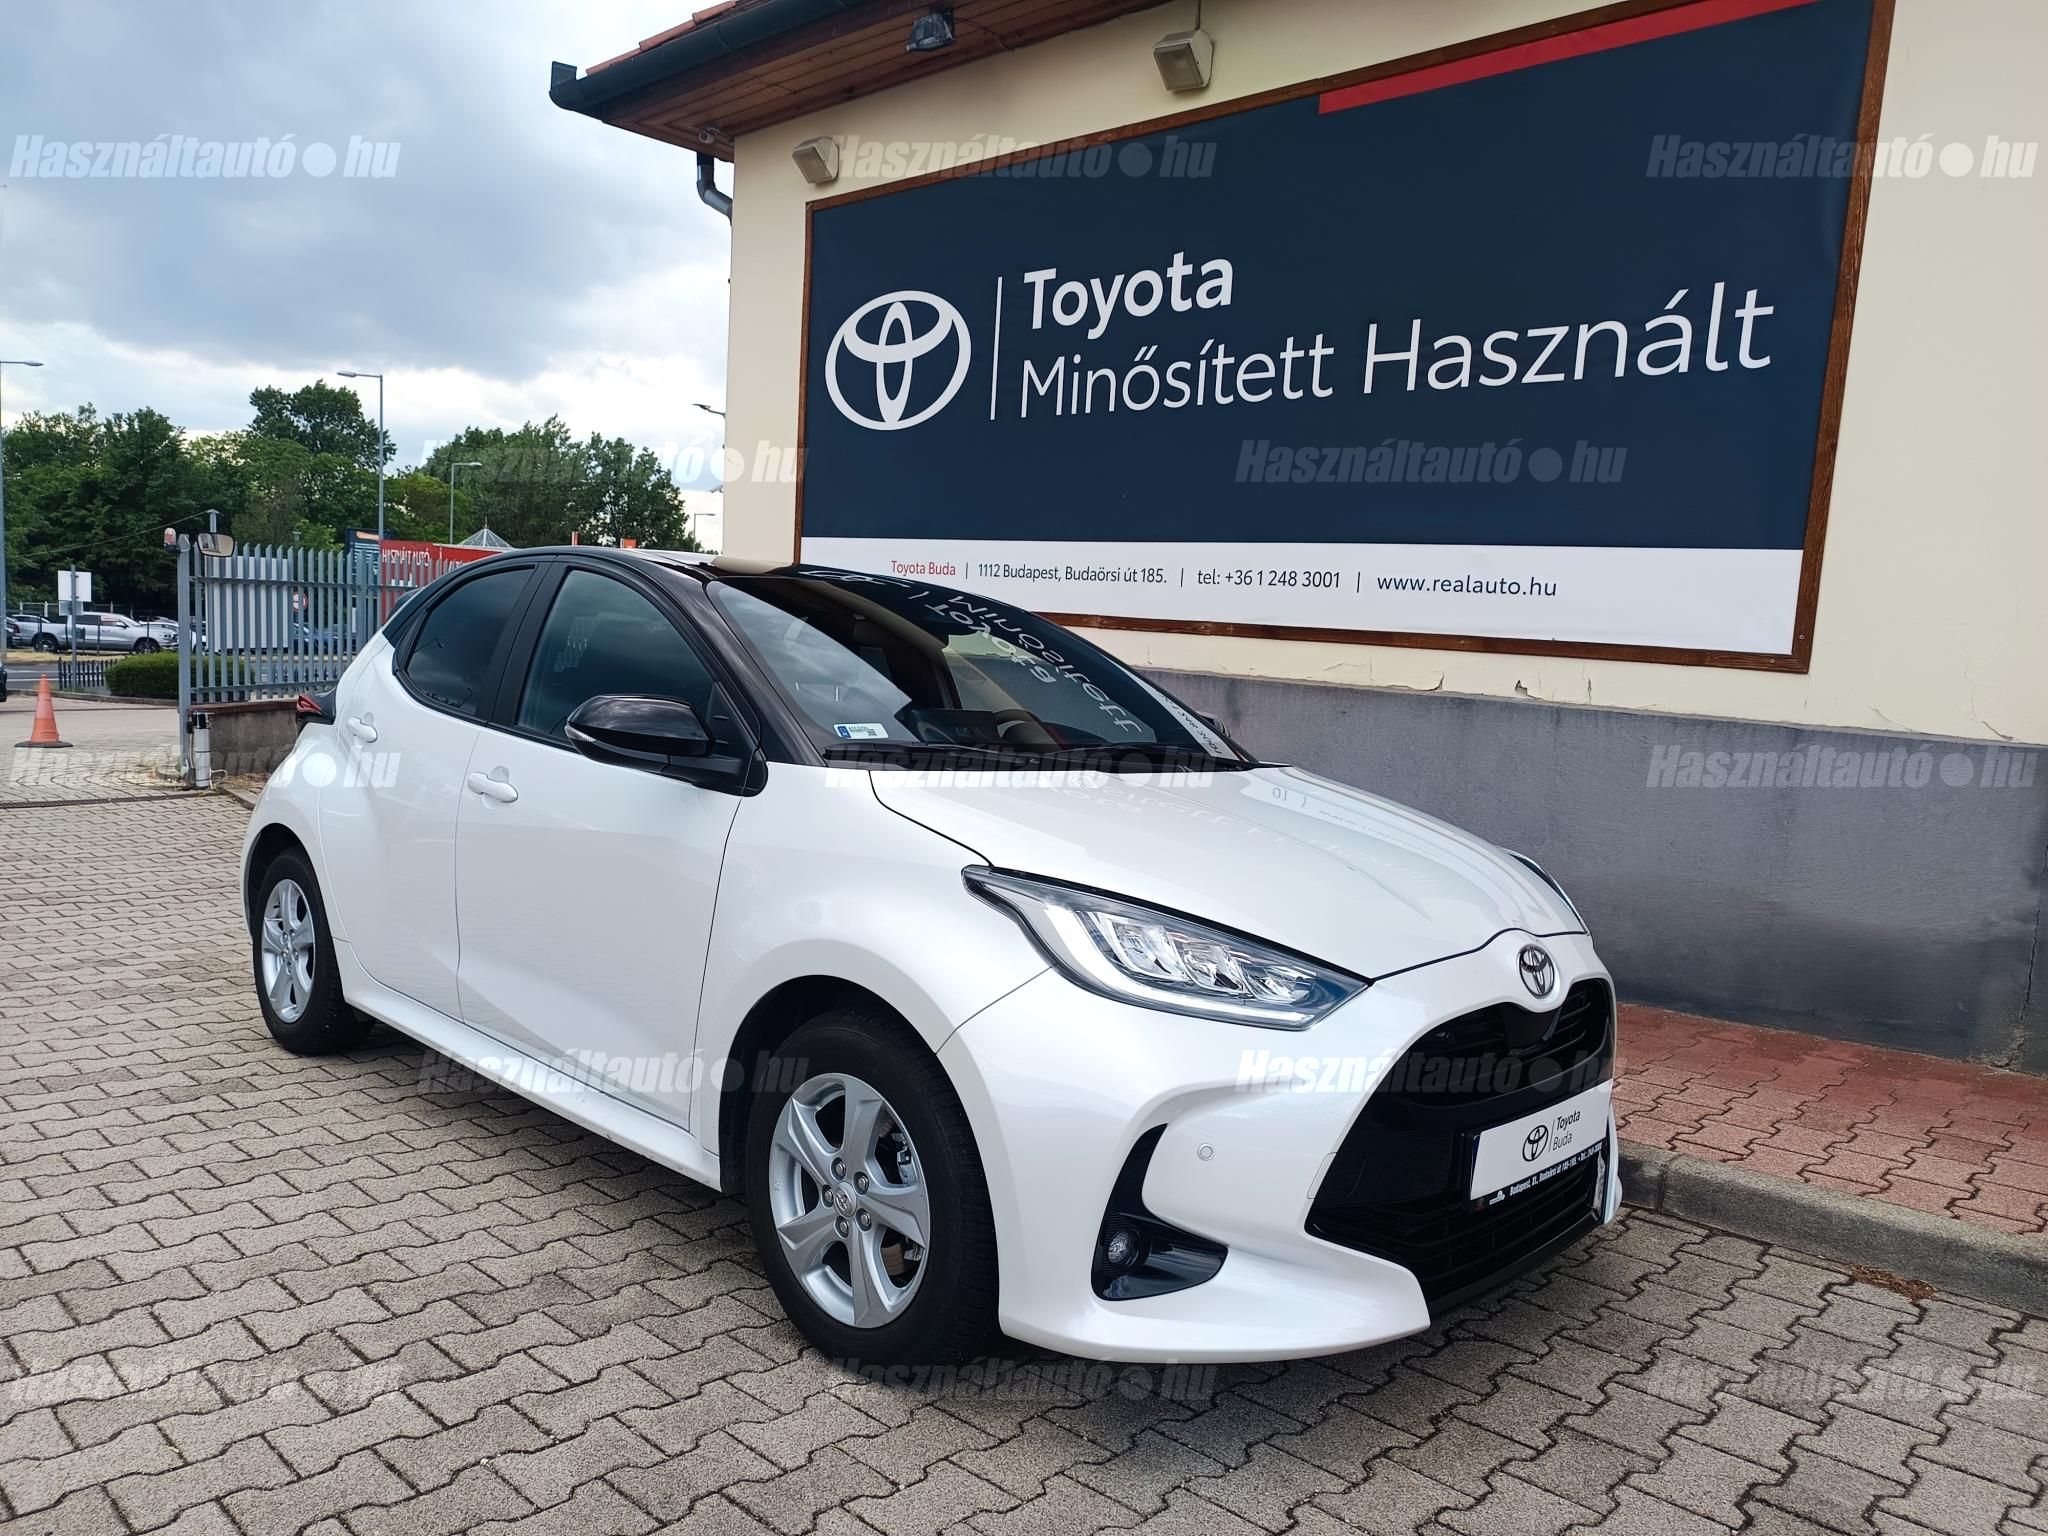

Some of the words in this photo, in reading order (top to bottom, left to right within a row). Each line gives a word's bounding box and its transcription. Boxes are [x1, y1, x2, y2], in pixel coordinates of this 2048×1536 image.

[1023, 251, 1234, 340] Toyota
[1020, 333, 1335, 418] Minősített
[1363, 281, 1775, 394] Használt
[890, 560, 926, 577] Toyota
[928, 561, 956, 576] Buda
[978, 563, 1000, 577] 1112
[1003, 563, 1062, 582] Budapest,
[1065, 565, 1120, 581] Budaörsi
[1123, 566, 1138, 582] út
[1140, 568, 1168, 584] 185.
[1197, 568, 1221, 585] tel:
[1225, 569, 1253, 586] +36
[1257, 570, 1264, 587] 1
[1267, 570, 1298, 587] 248
[1302, 571, 1341, 588] 3001
[1377, 574, 1558, 596] www.realauto.hu
[1556, 1110, 1581, 1130] Toyota
[1552, 1132, 1573, 1151] Buda
